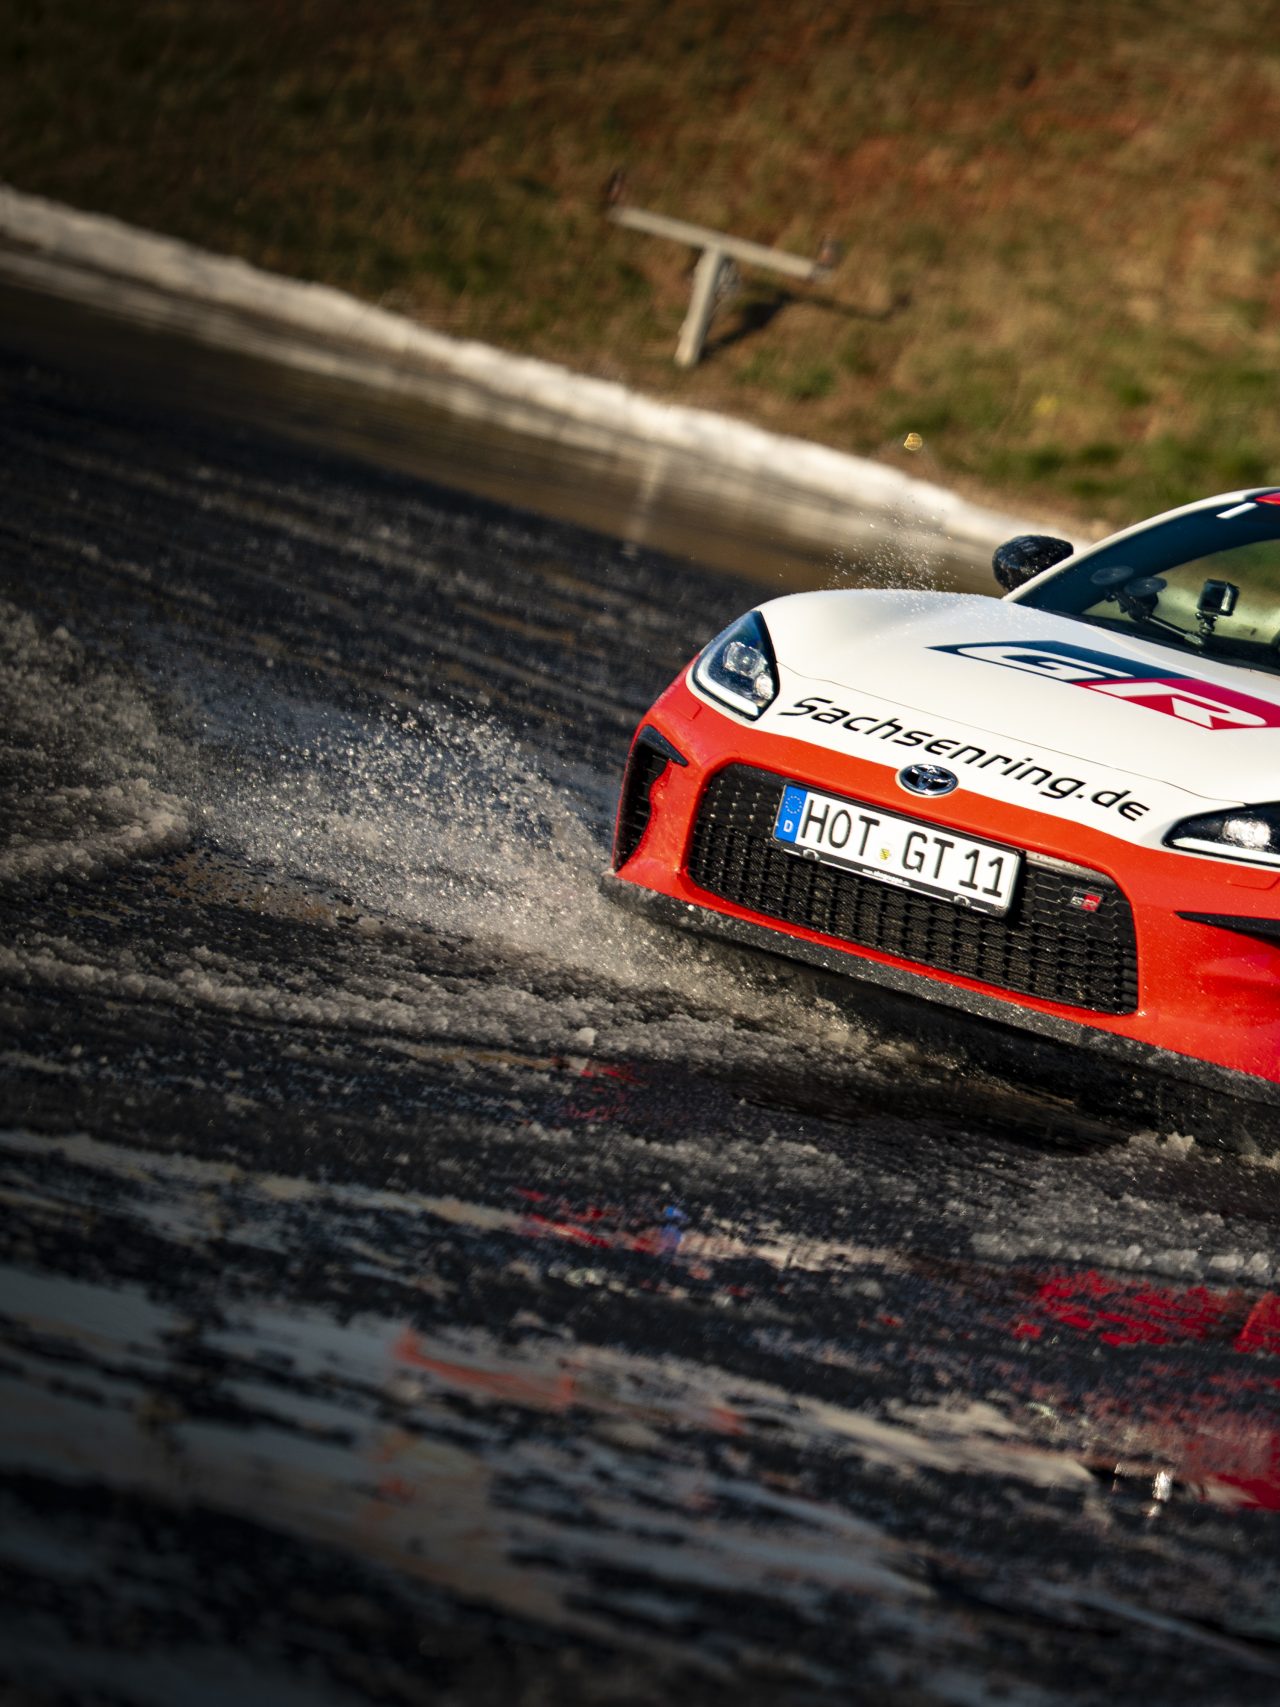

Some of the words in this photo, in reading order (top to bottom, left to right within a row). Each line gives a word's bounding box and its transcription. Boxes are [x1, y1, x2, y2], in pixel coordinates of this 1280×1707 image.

[778, 696, 1150, 822] Sachsenring.de
[783, 819, 793, 833] D
[800, 799, 880, 857] HOT
[901, 831, 954, 880] GT
[958, 849, 1005, 898] 11
